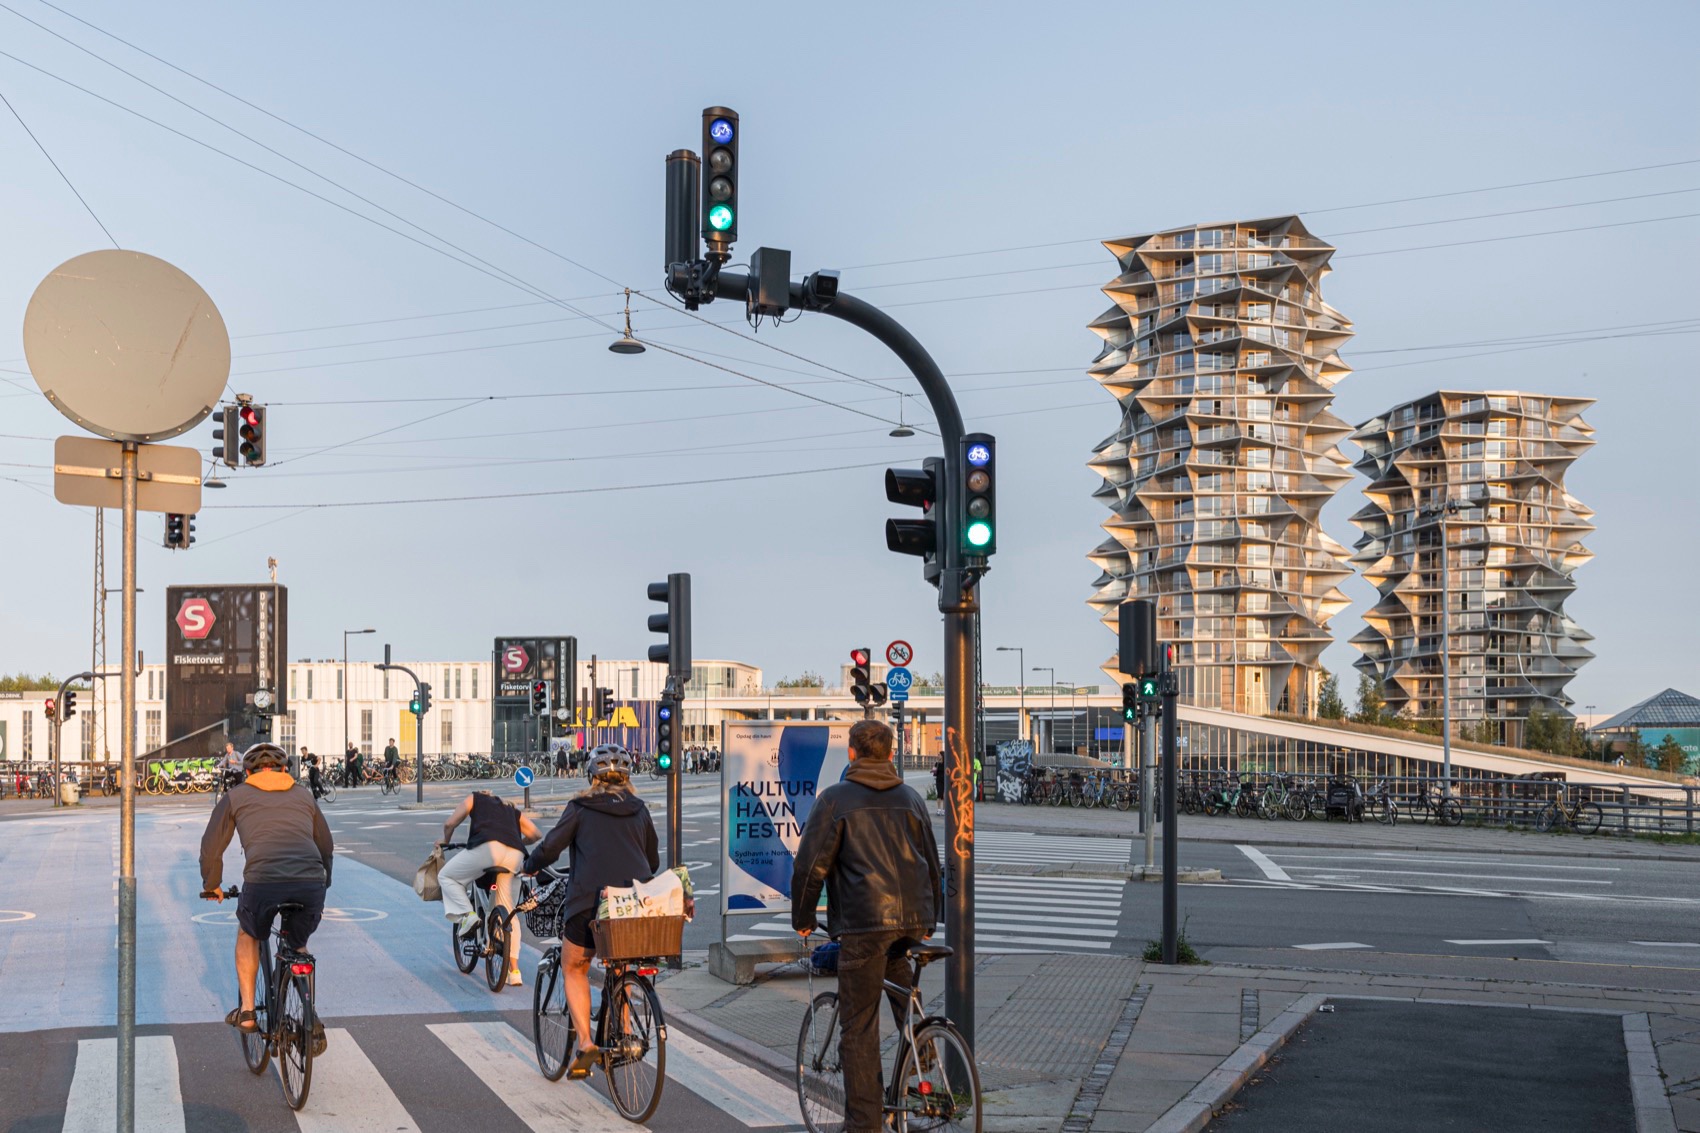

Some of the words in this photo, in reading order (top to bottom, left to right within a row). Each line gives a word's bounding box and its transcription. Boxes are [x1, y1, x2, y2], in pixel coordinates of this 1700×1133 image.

[184, 605, 206, 631] S
[174, 655, 224, 665] Fisketorvet
[507, 650, 523, 668] S
[736, 781, 815, 797] KULTUR
[736, 802, 796, 818] HAVN
[735, 850, 764, 859] Sydhavn
